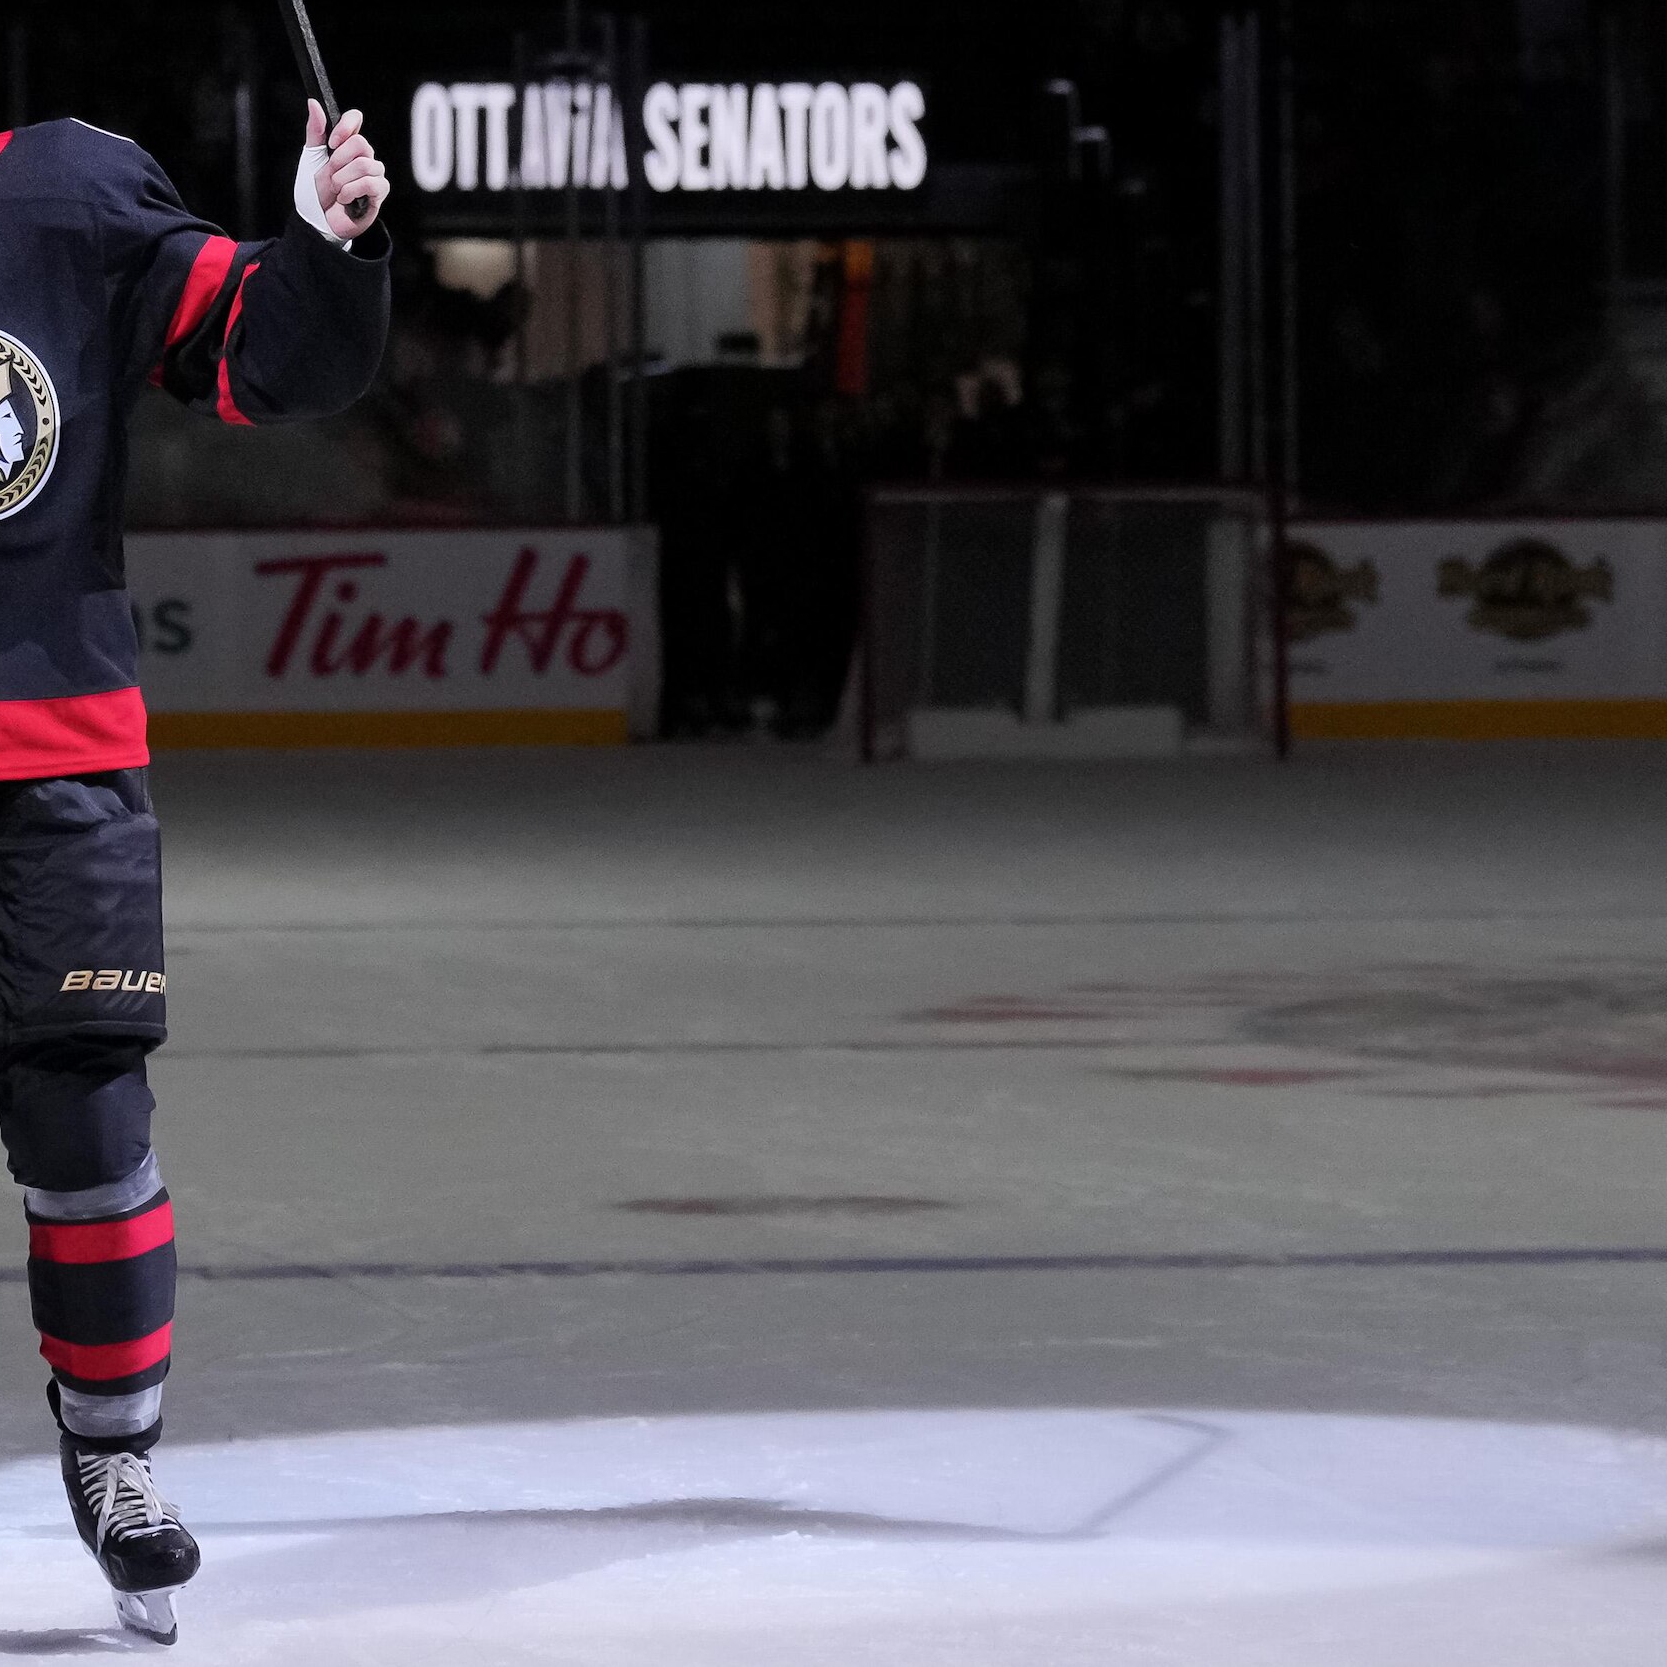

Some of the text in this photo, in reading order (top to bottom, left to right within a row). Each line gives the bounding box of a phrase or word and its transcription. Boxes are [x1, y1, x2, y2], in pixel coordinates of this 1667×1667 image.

[411, 82, 927, 192] OTTAWA SENATORS
[253, 551, 455, 679] Tim
